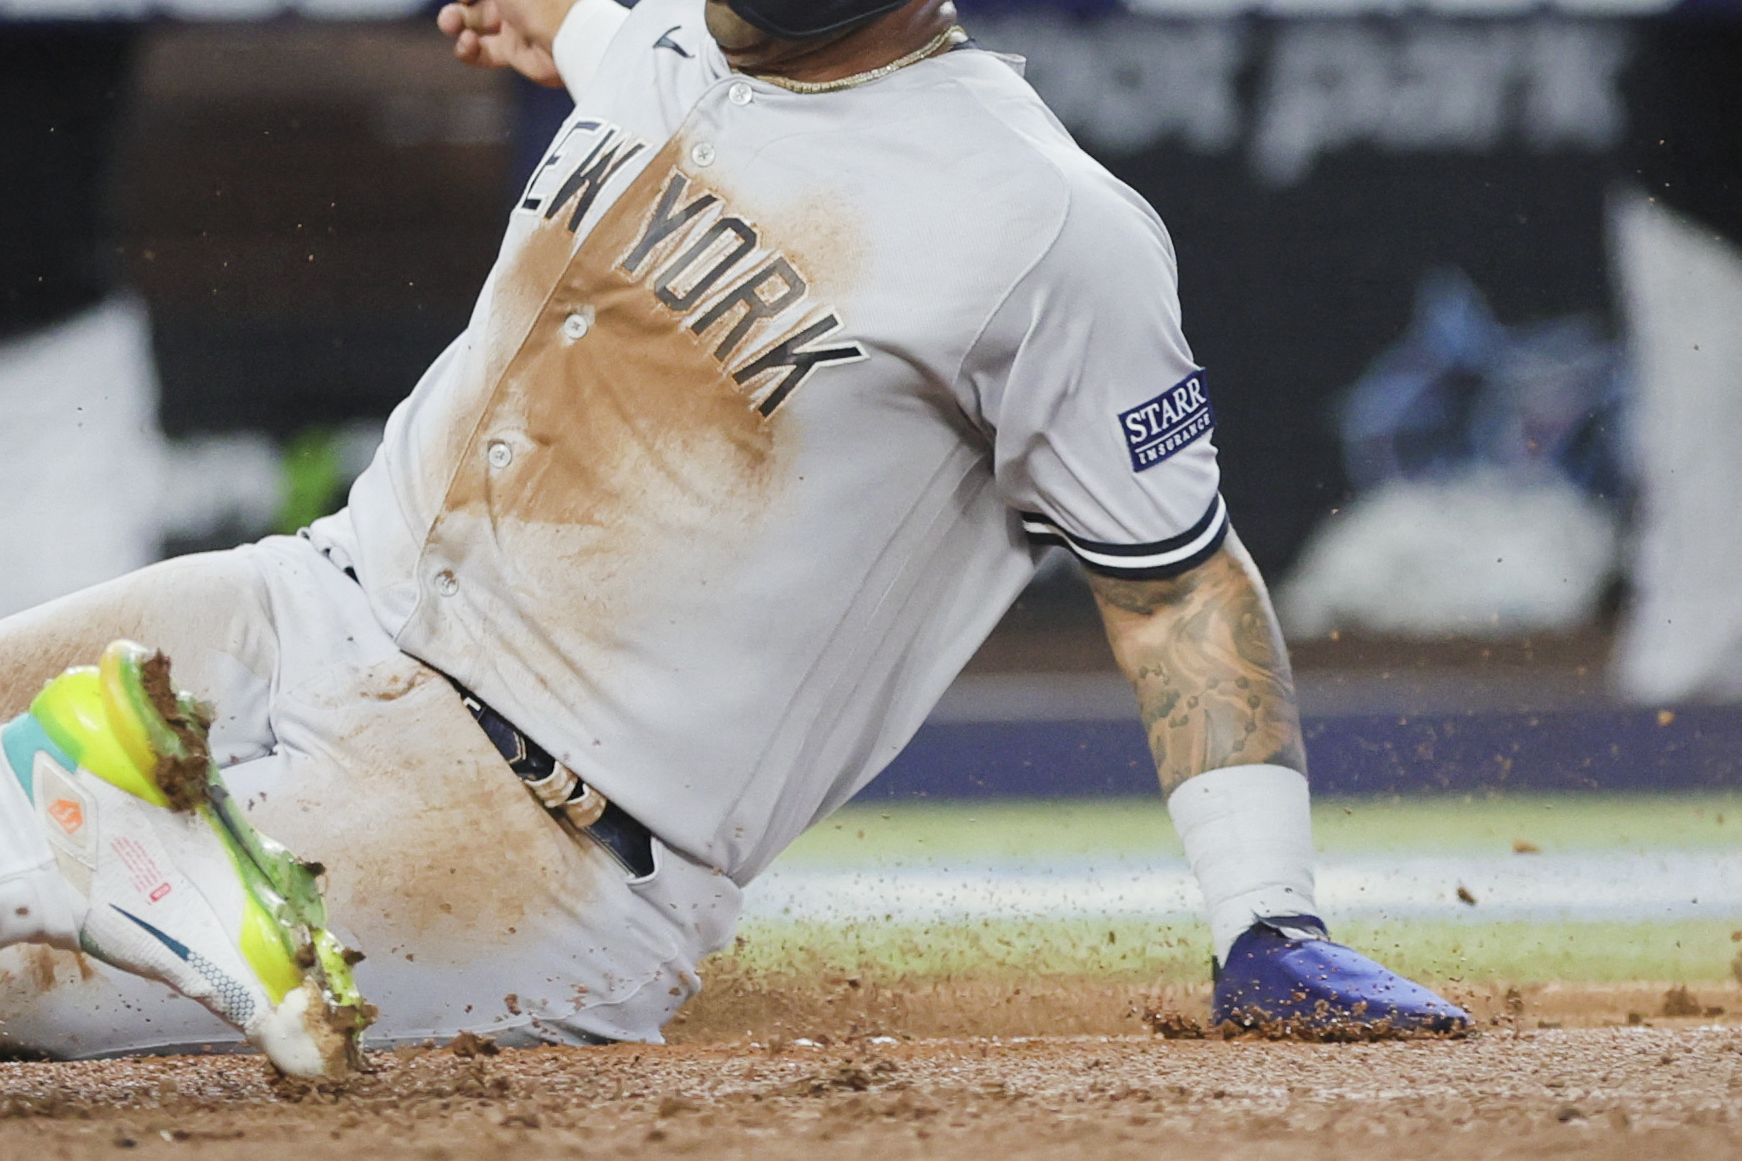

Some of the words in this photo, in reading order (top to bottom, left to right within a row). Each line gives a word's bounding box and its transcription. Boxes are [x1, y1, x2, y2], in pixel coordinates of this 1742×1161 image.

[518, 116, 652, 235] EW
[612, 164, 870, 422] YORK
[1125, 378, 1207, 444] STARR
[1138, 413, 1210, 464] INSURANCE
